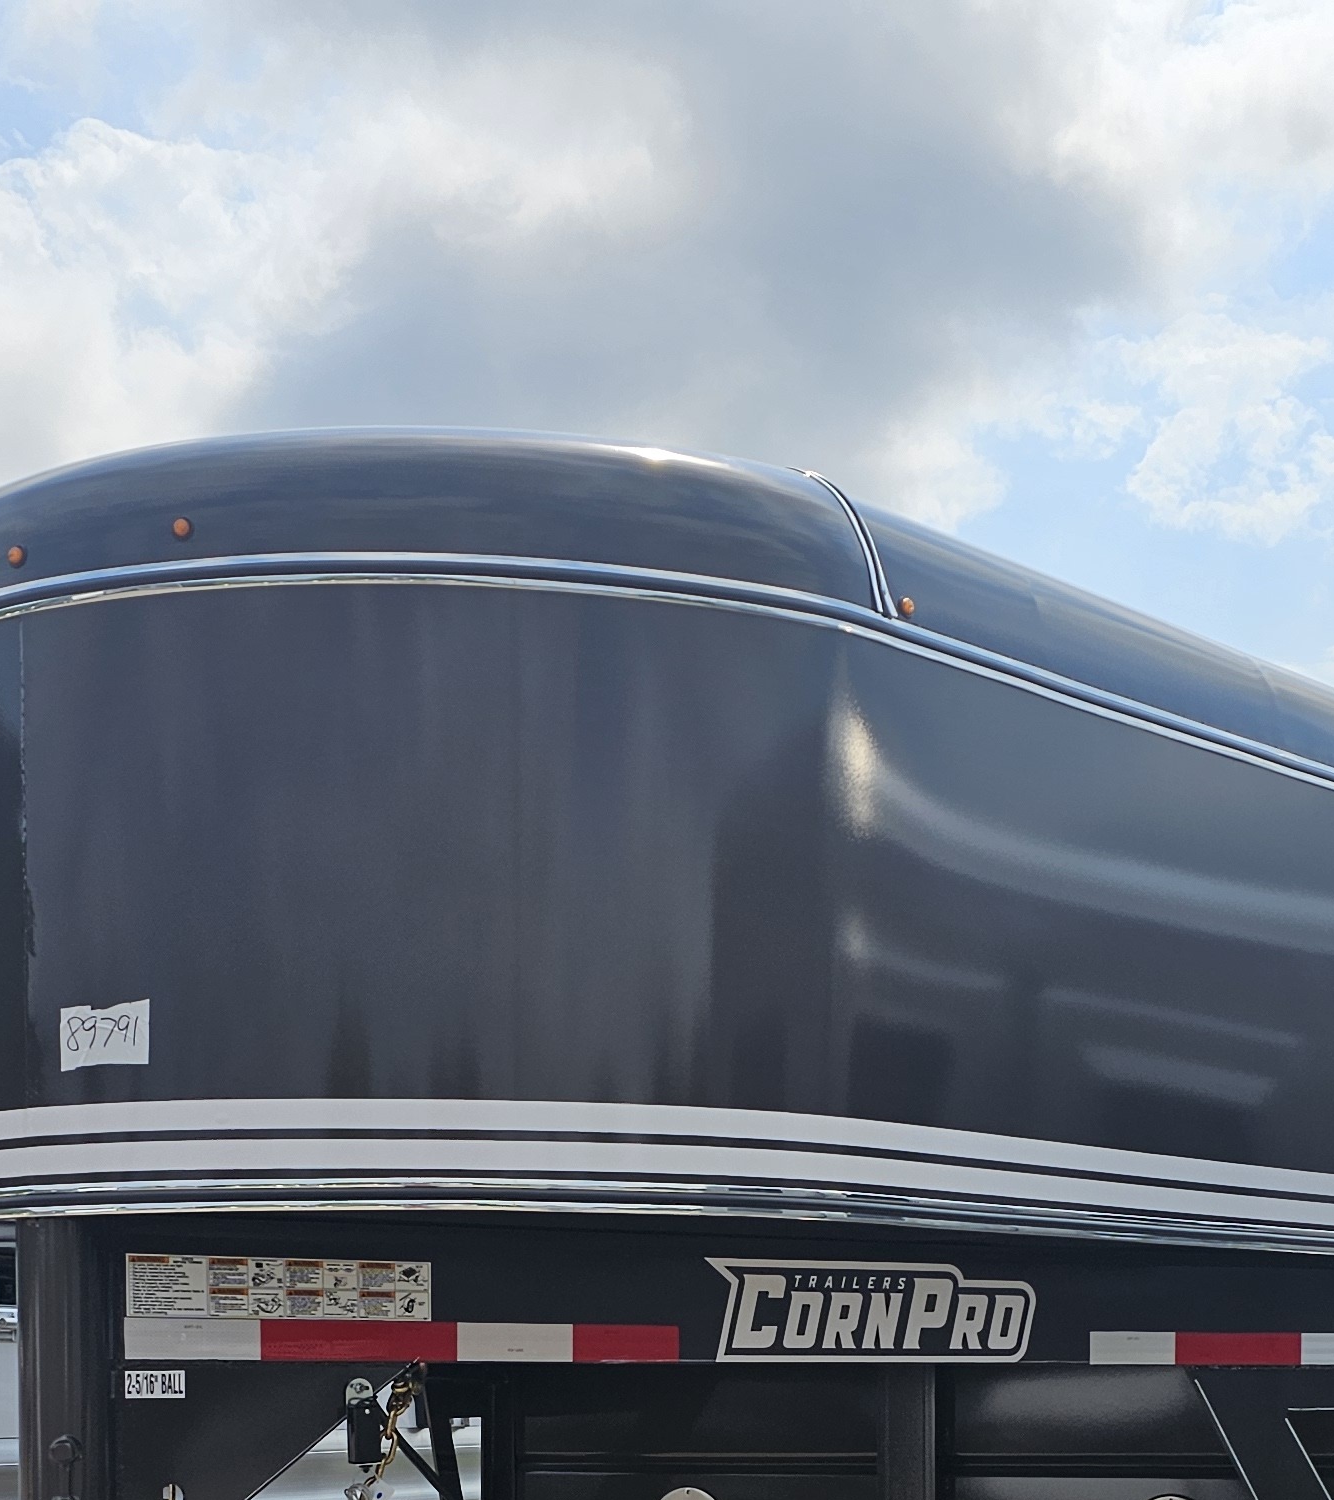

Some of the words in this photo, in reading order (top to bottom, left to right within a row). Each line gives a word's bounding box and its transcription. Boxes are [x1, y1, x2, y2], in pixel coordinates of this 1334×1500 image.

[66, 1014, 139, 1052] 89791
[793, 1274, 907, 1291] TRAILERS
[161, 1373, 184, 1395] BALL
